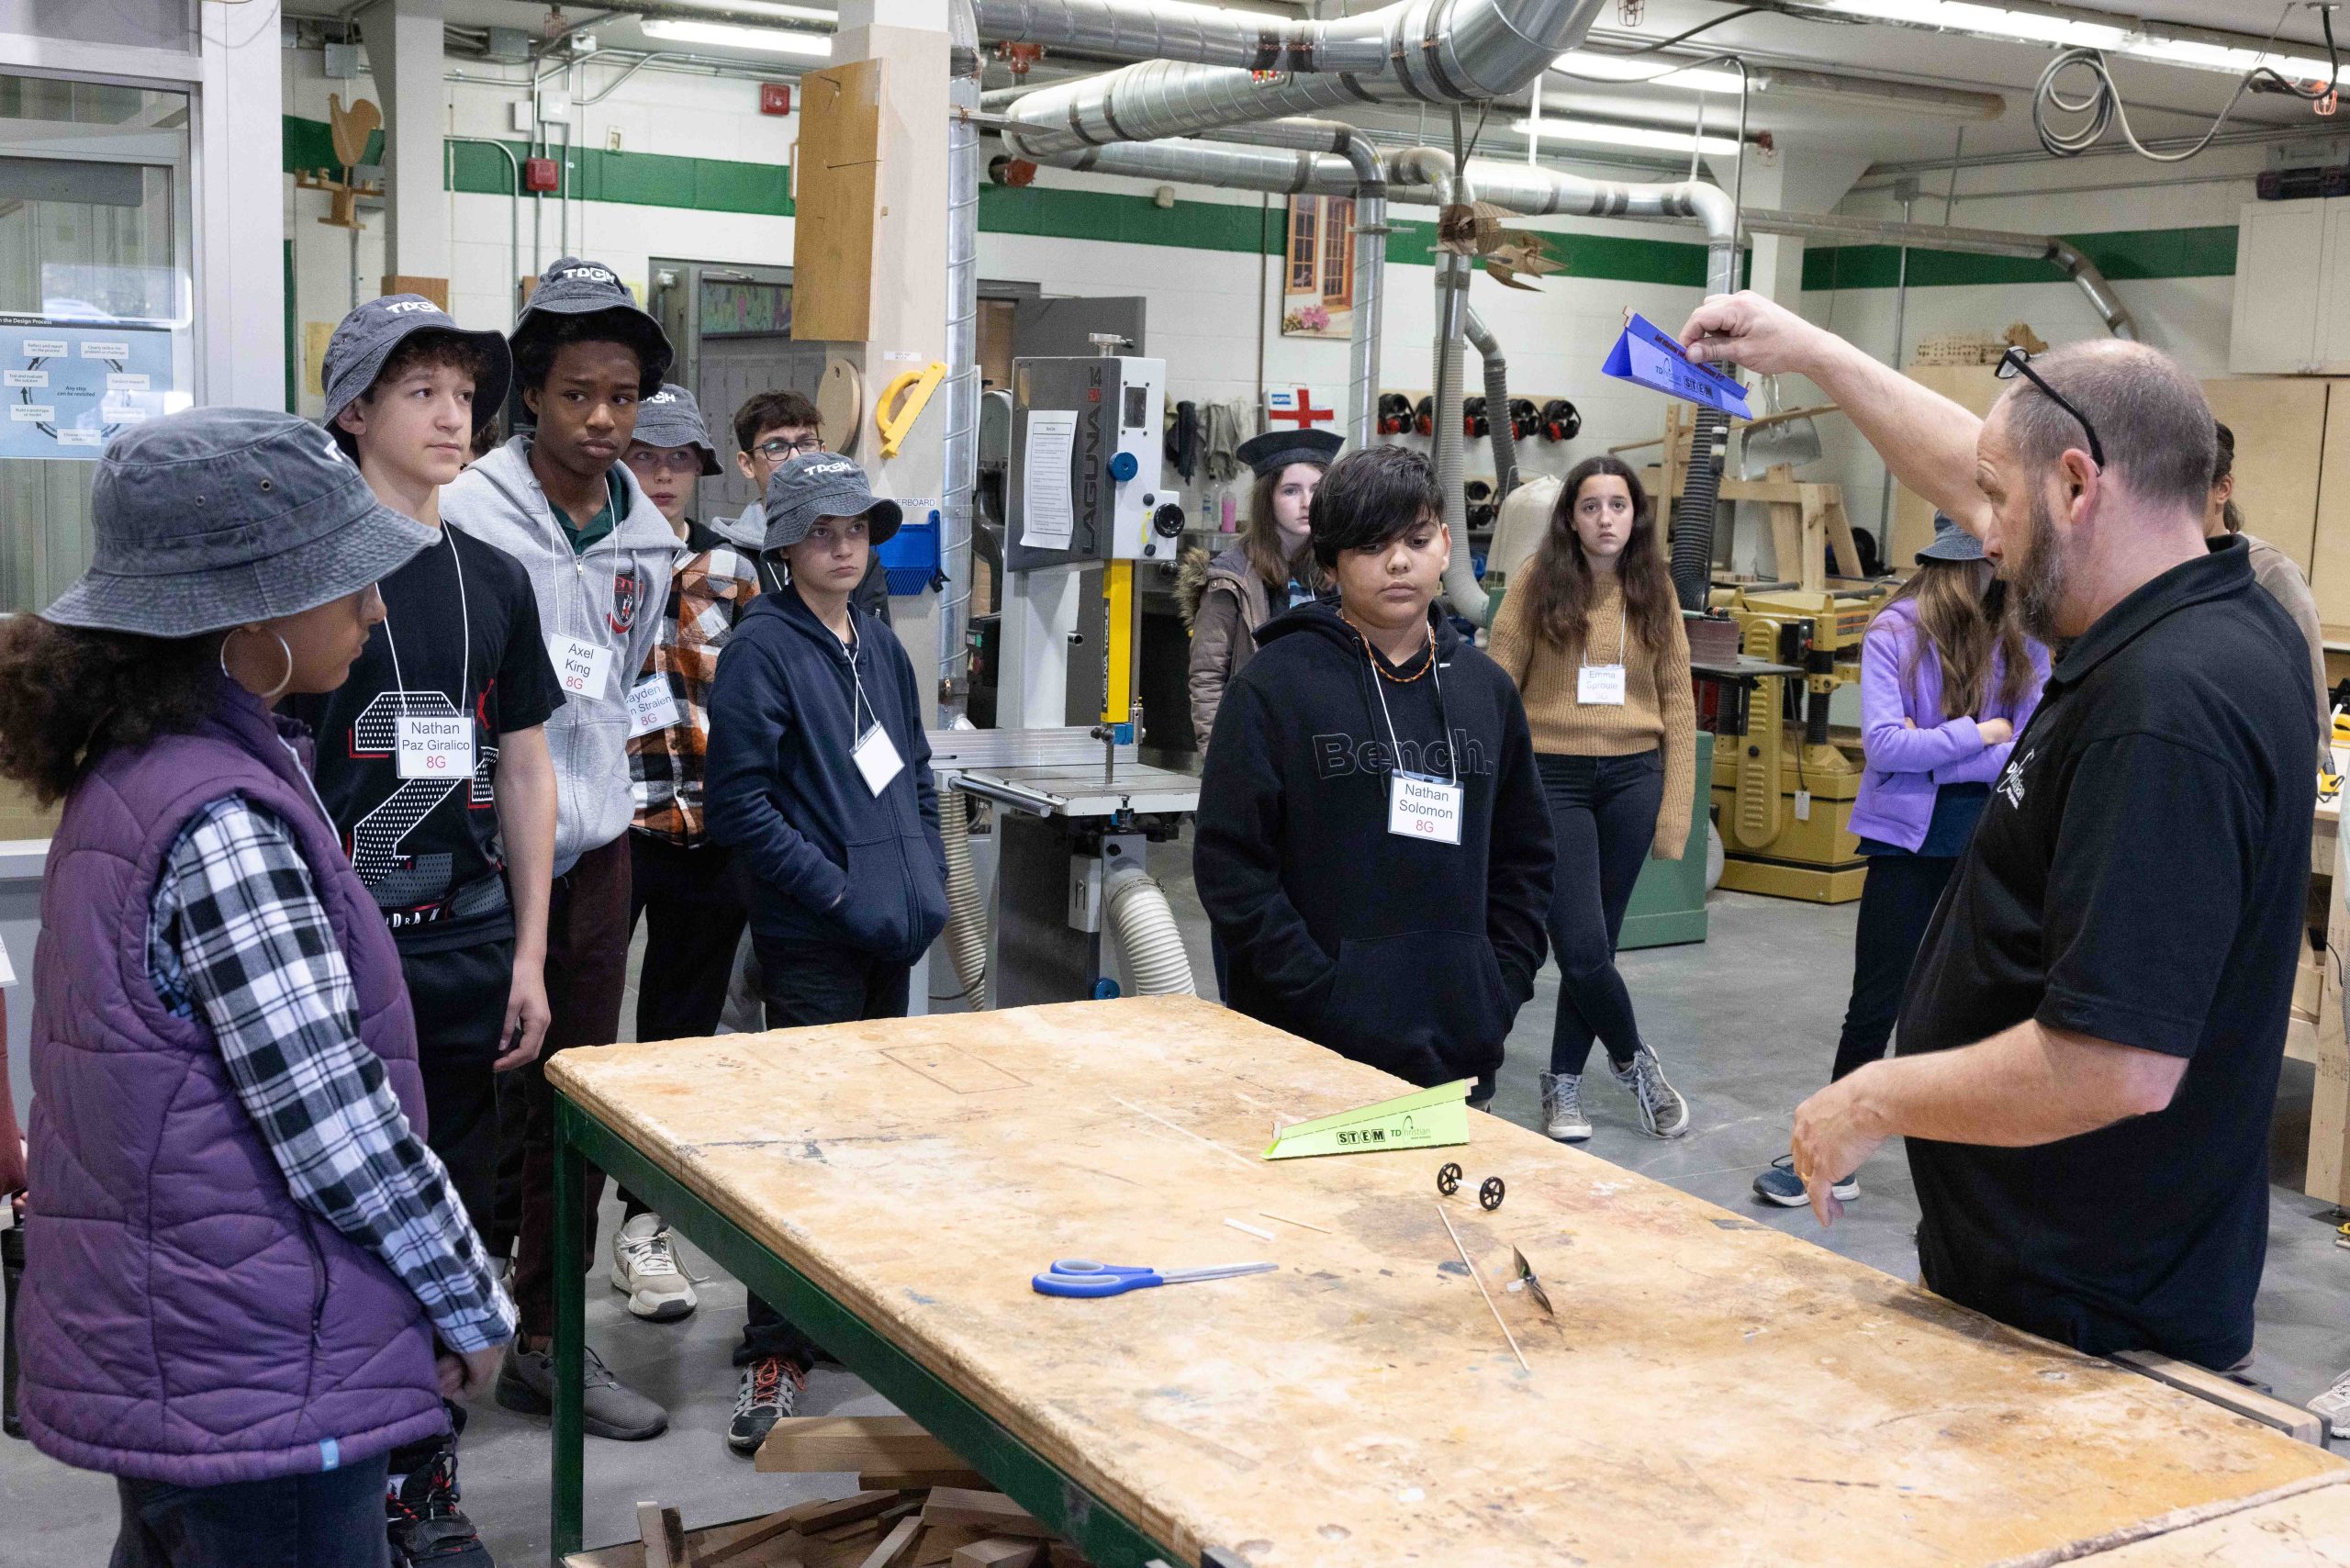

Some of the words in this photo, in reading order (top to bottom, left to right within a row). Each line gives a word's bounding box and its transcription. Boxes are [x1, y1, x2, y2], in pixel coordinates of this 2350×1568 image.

[804, 463, 852, 476] TDCH
[1082, 405, 1102, 554] LAGUNA
[894, 498, 935, 507] ERBOARD
[568, 643, 595, 659] Axel
[565, 658, 591, 678] King
[1589, 670, 1616, 678] Emma
[566, 676, 584, 689] 8G
[626, 686, 661, 703] ayden
[640, 713, 658, 726] 8G
[411, 722, 461, 734] Nathan
[402, 740, 424, 751] Paz
[427, 739, 470, 751] Giralico
[426, 756, 446, 768] 8G
[1404, 783, 1449, 801] Nathan
[1399, 799, 1453, 820] Solomon
[1416, 819, 1434, 833] 8G
[1337, 1130, 1384, 1144] STEM
